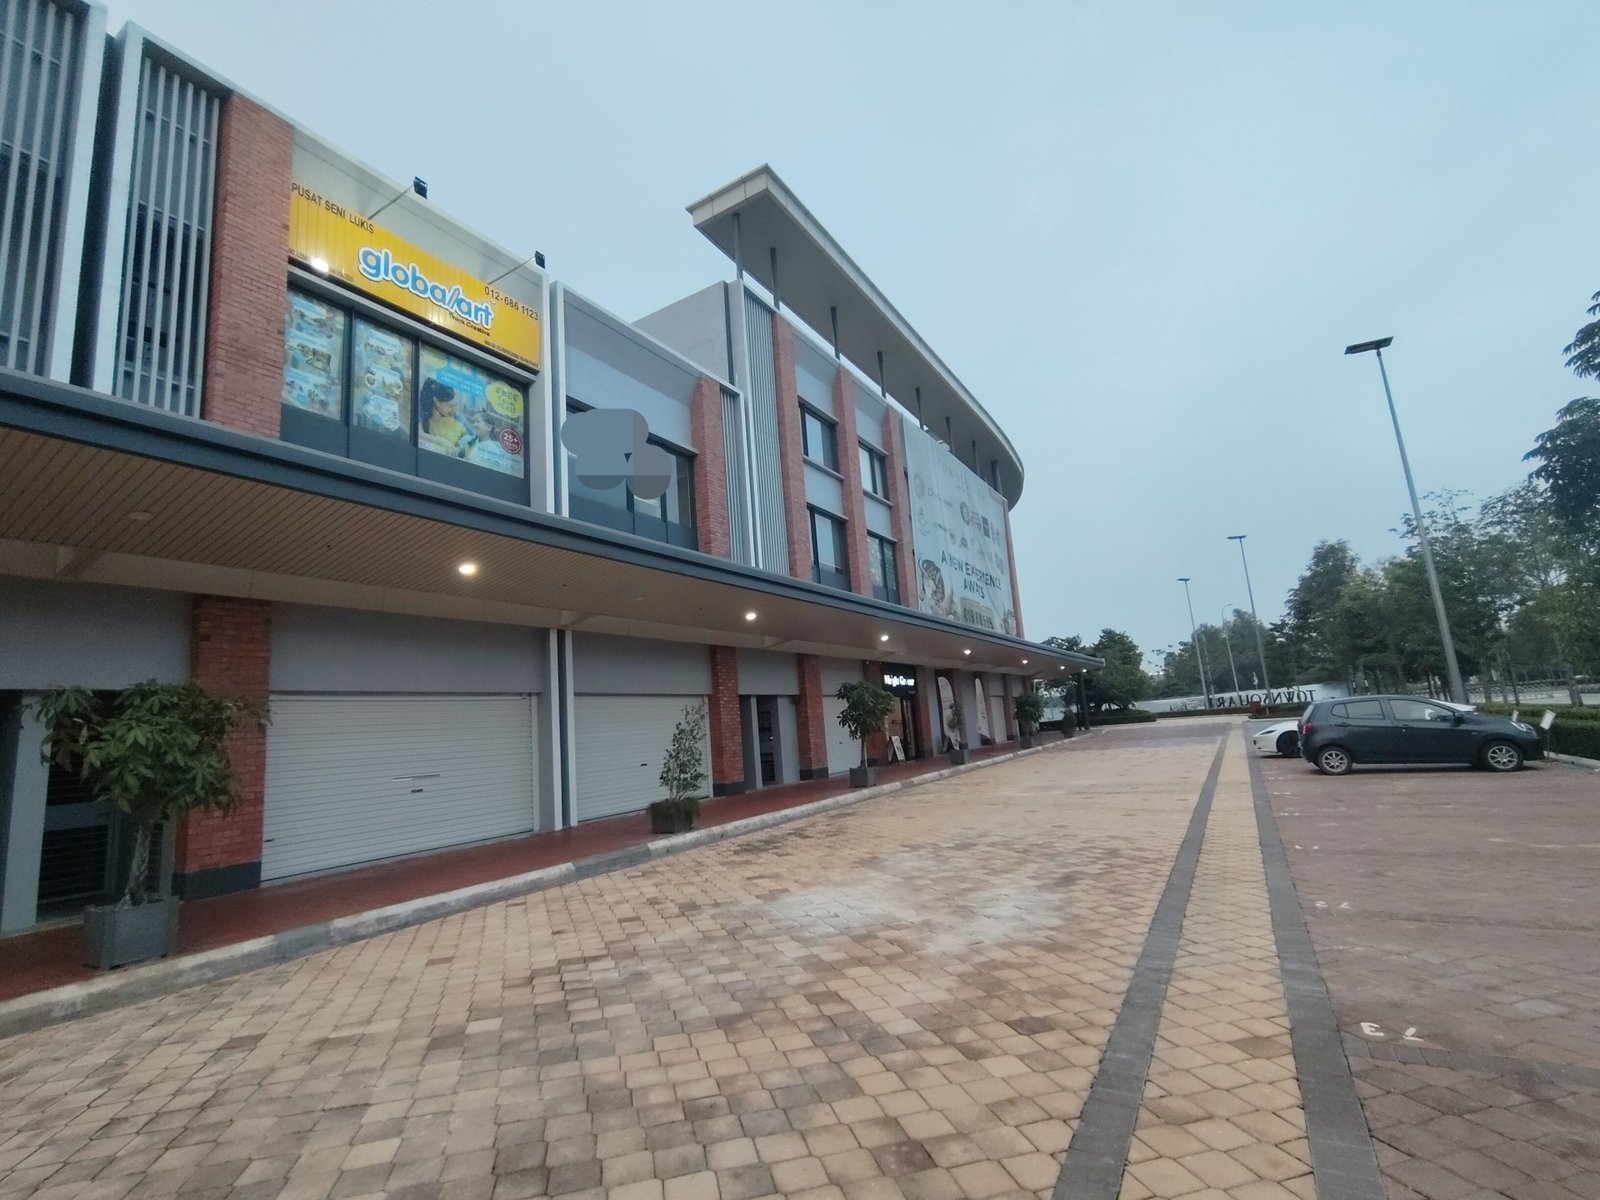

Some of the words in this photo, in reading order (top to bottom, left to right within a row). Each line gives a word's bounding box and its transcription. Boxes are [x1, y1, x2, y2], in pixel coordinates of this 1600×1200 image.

[291, 182, 322, 206] PUSAT
[325, 200, 346, 219] SENI
[349, 213, 375, 234] LUKIS
[484, 286, 519, 311] 012-686
[521, 305, 539, 321] 1123
[941, 550, 947, 564] A
